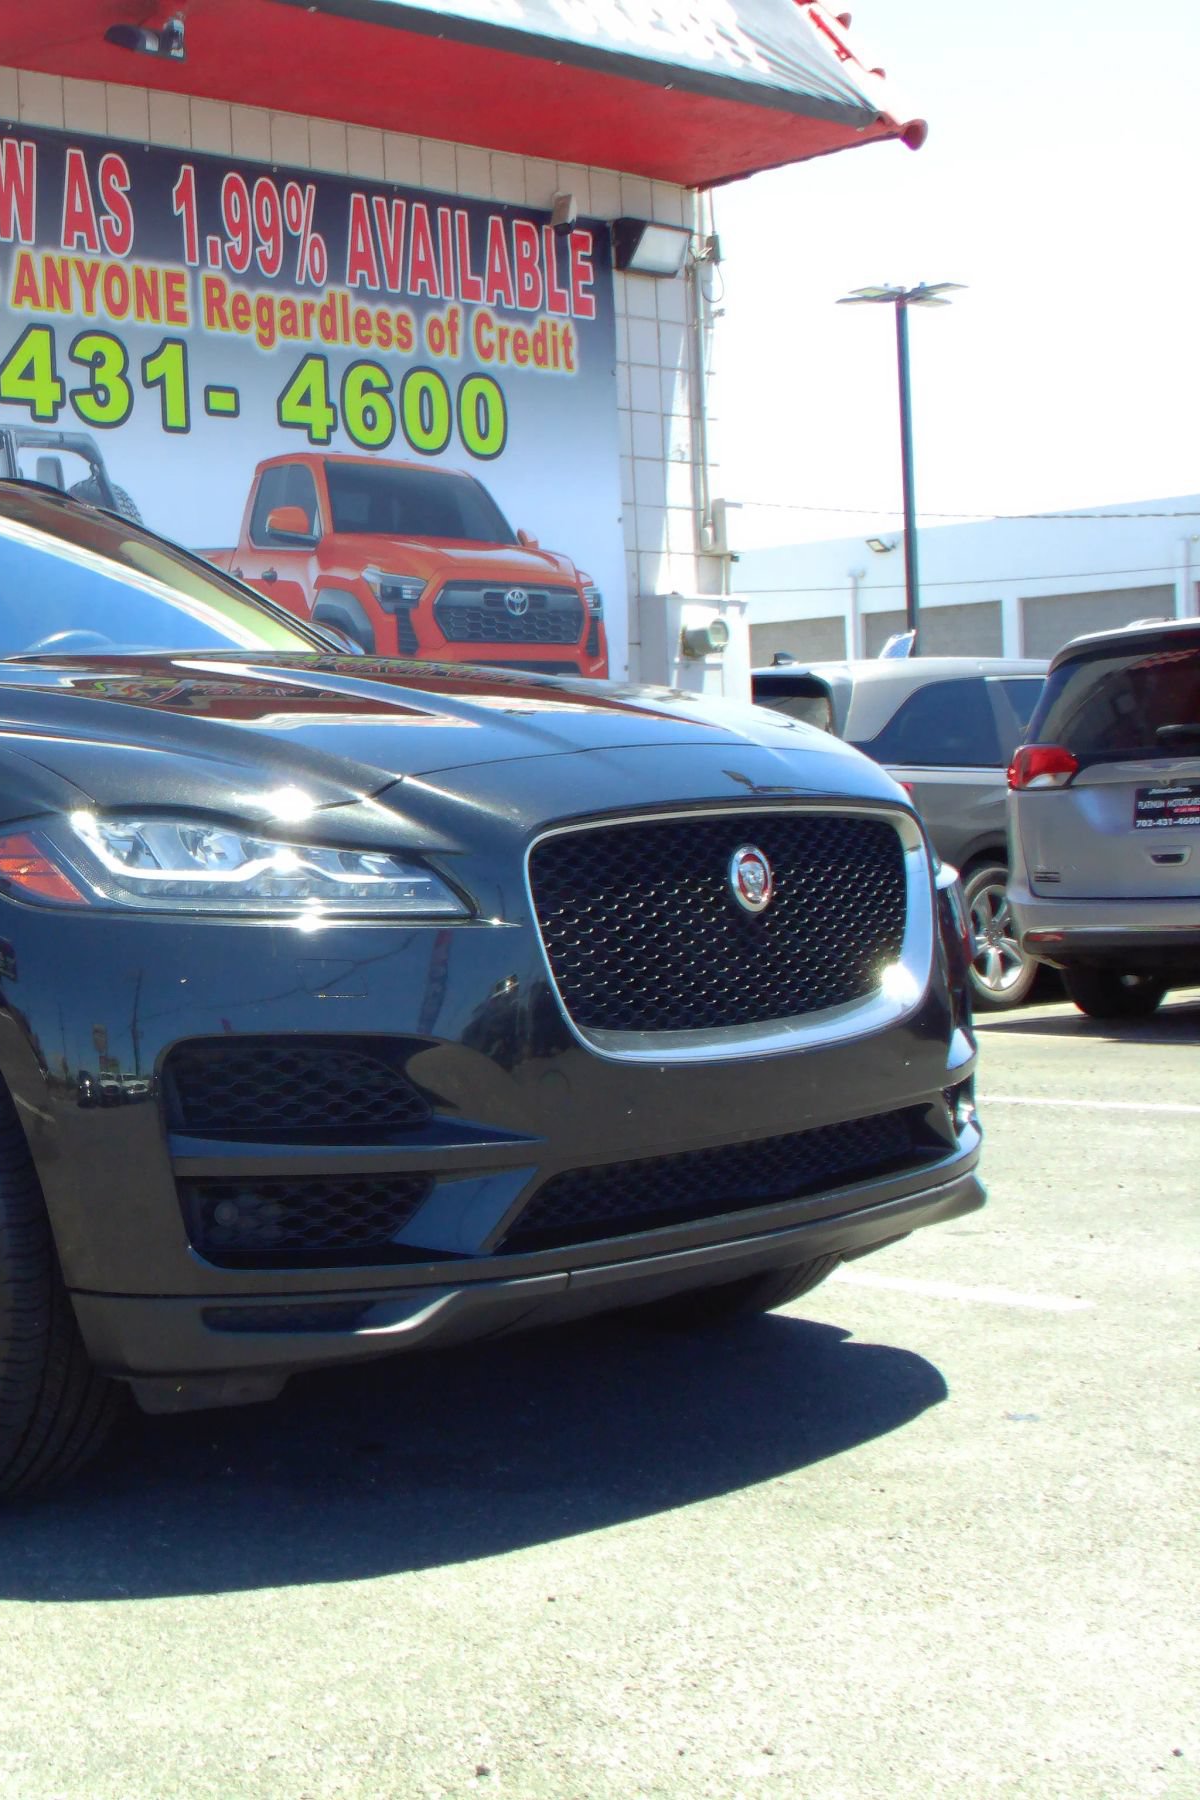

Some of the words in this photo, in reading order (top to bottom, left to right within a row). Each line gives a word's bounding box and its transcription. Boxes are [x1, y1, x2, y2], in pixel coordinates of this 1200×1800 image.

[61, 148, 135, 258] AS
[172, 164, 328, 287] 1.99%
[346, 192, 597, 320] AVAILABLE
[12, 252, 190, 325] ANYONE
[203, 273, 414, 351] Regardless
[426, 307, 462, 358] of
[474, 310, 574, 372] Credit
[277, 352, 508, 461] 4600
